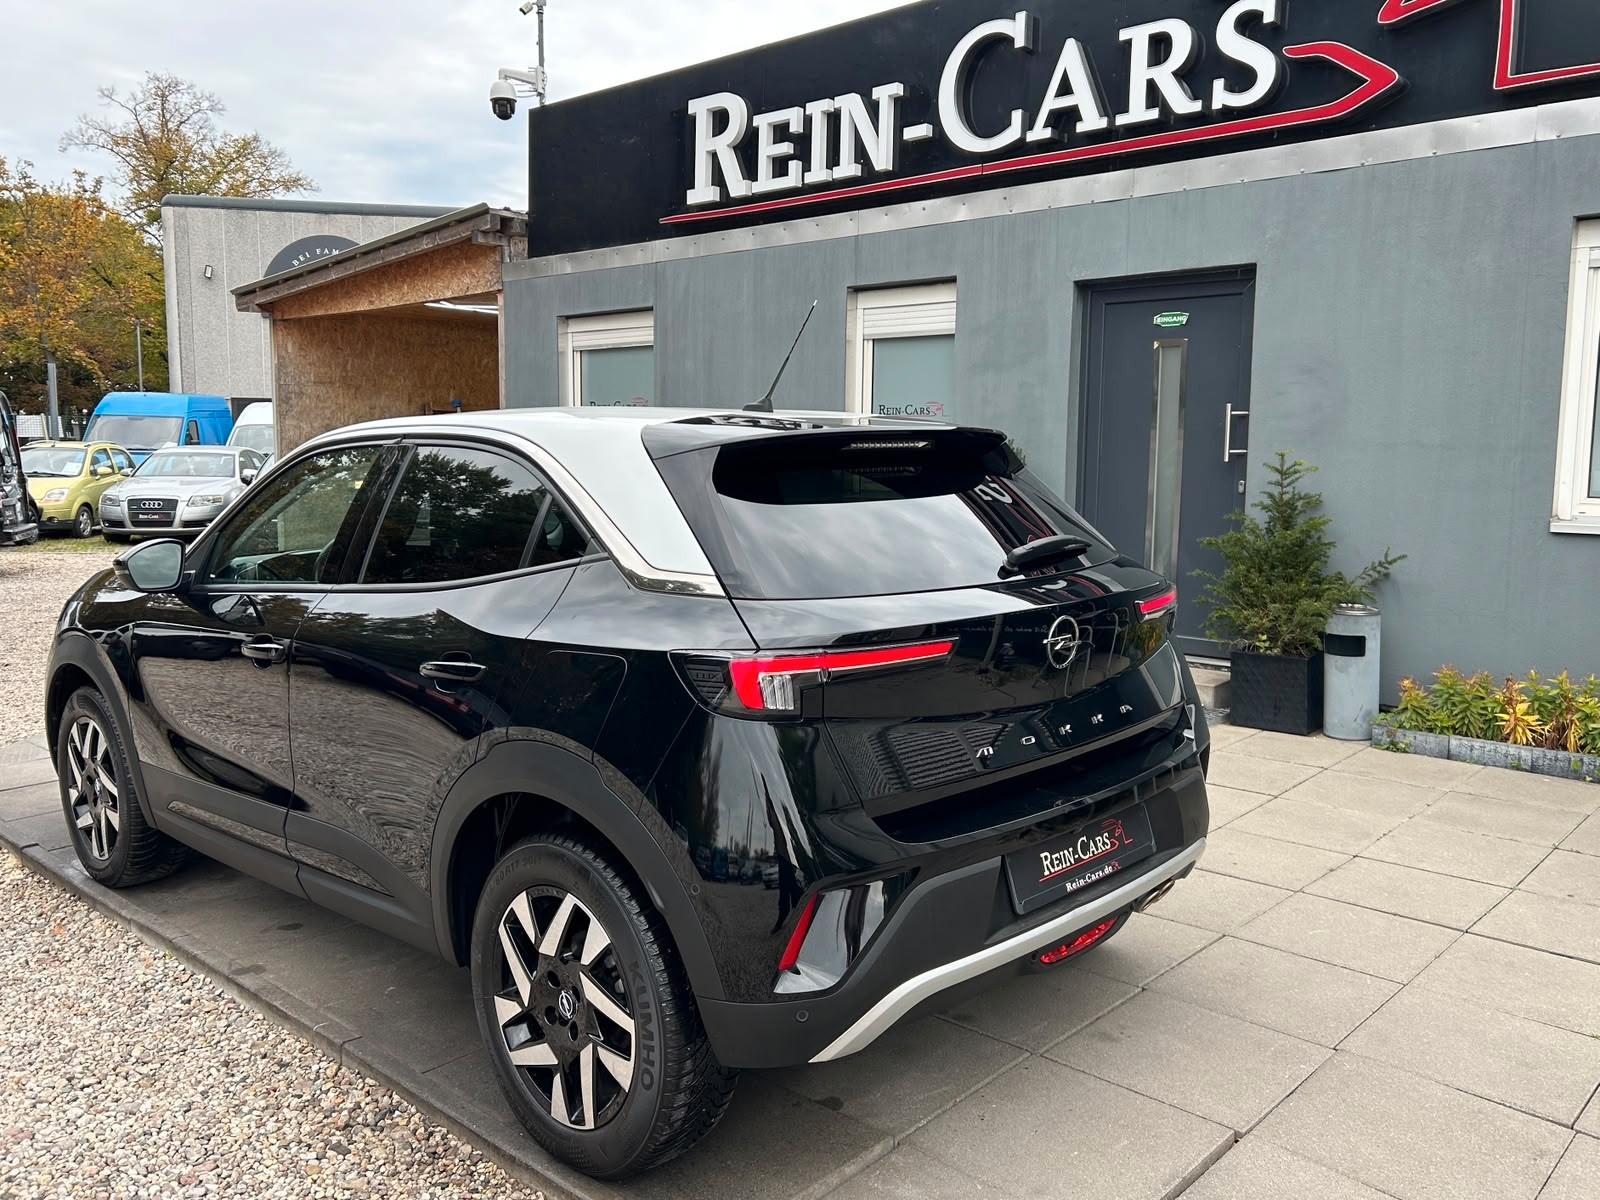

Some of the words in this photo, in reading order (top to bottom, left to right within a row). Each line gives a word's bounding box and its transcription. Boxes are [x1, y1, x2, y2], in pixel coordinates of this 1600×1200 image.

[686, 0, 1283, 205] REIN-CARS
[291, 251, 311, 267] BEI
[1156, 315, 1188, 323] EINGANG
[879, 404, 931, 416] REIN-CARS
[976, 704, 1133, 758] MOKKA
[1040, 832, 1112, 876] REIN-CARS
[1065, 864, 1114, 893] Rein-Cars.de
[628, 961, 656, 1092] KUMHO
